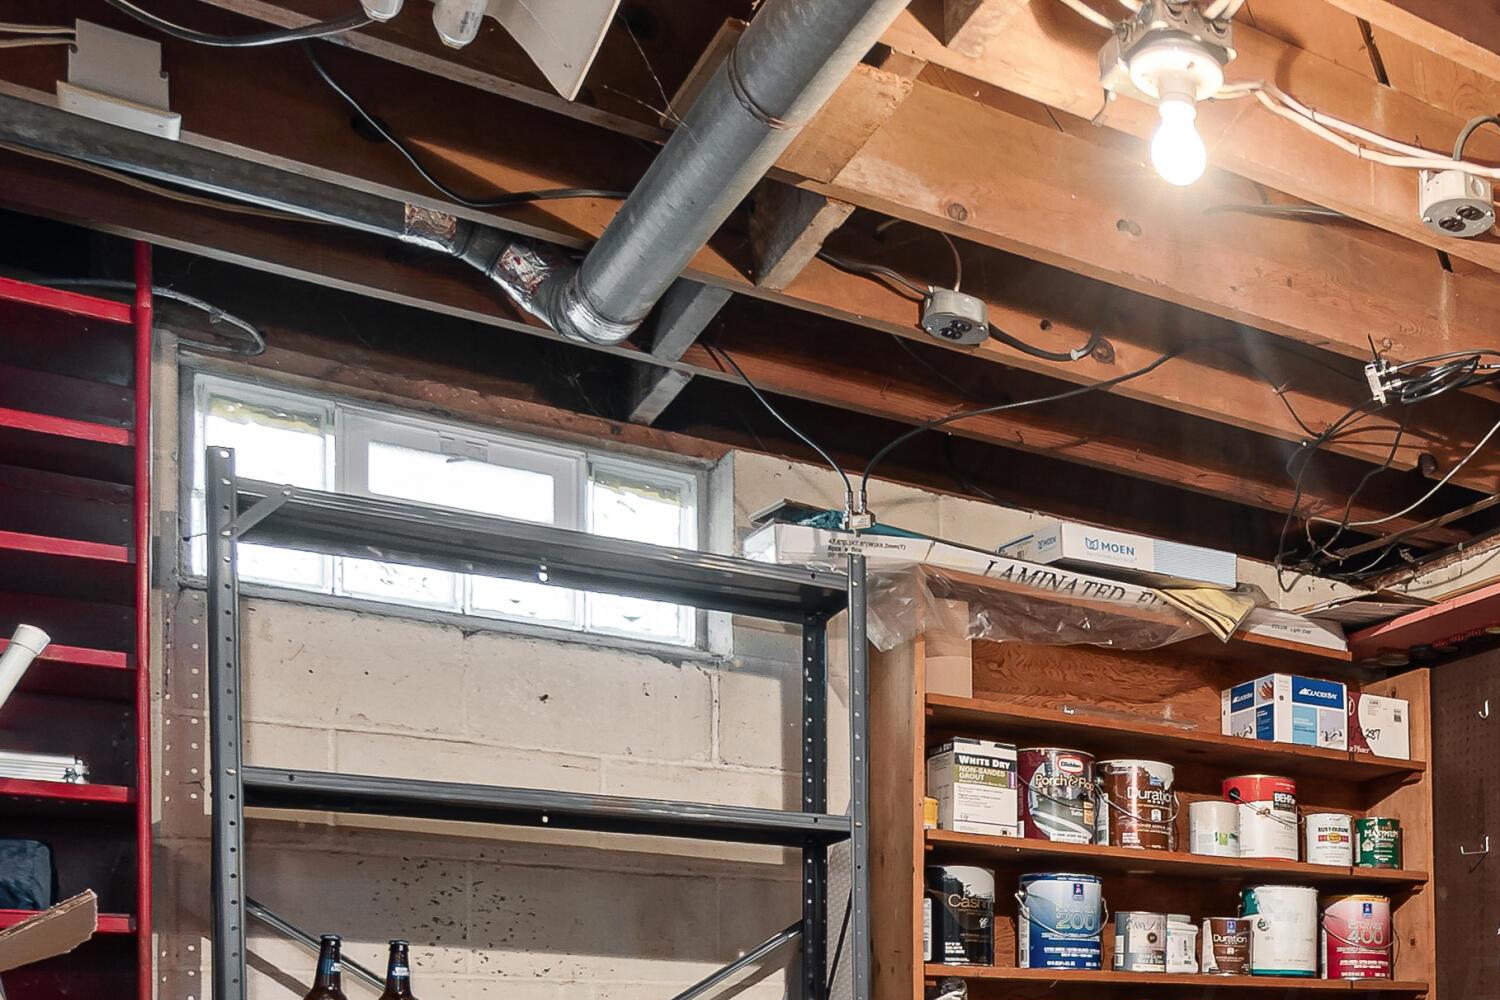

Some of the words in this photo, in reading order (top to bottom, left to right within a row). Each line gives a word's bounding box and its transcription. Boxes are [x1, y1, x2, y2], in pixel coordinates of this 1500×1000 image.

[1101, 541, 1135, 556] MOEN
[958, 755, 991, 767] WHITE
[992, 757, 1011, 769] DRY
[958, 773, 986, 781] GROUT
[1035, 773, 1066, 787] Porch
[1068, 775, 1078, 788] &
[1055, 911, 1096, 930] 200
[1348, 924, 1384, 945] 400
